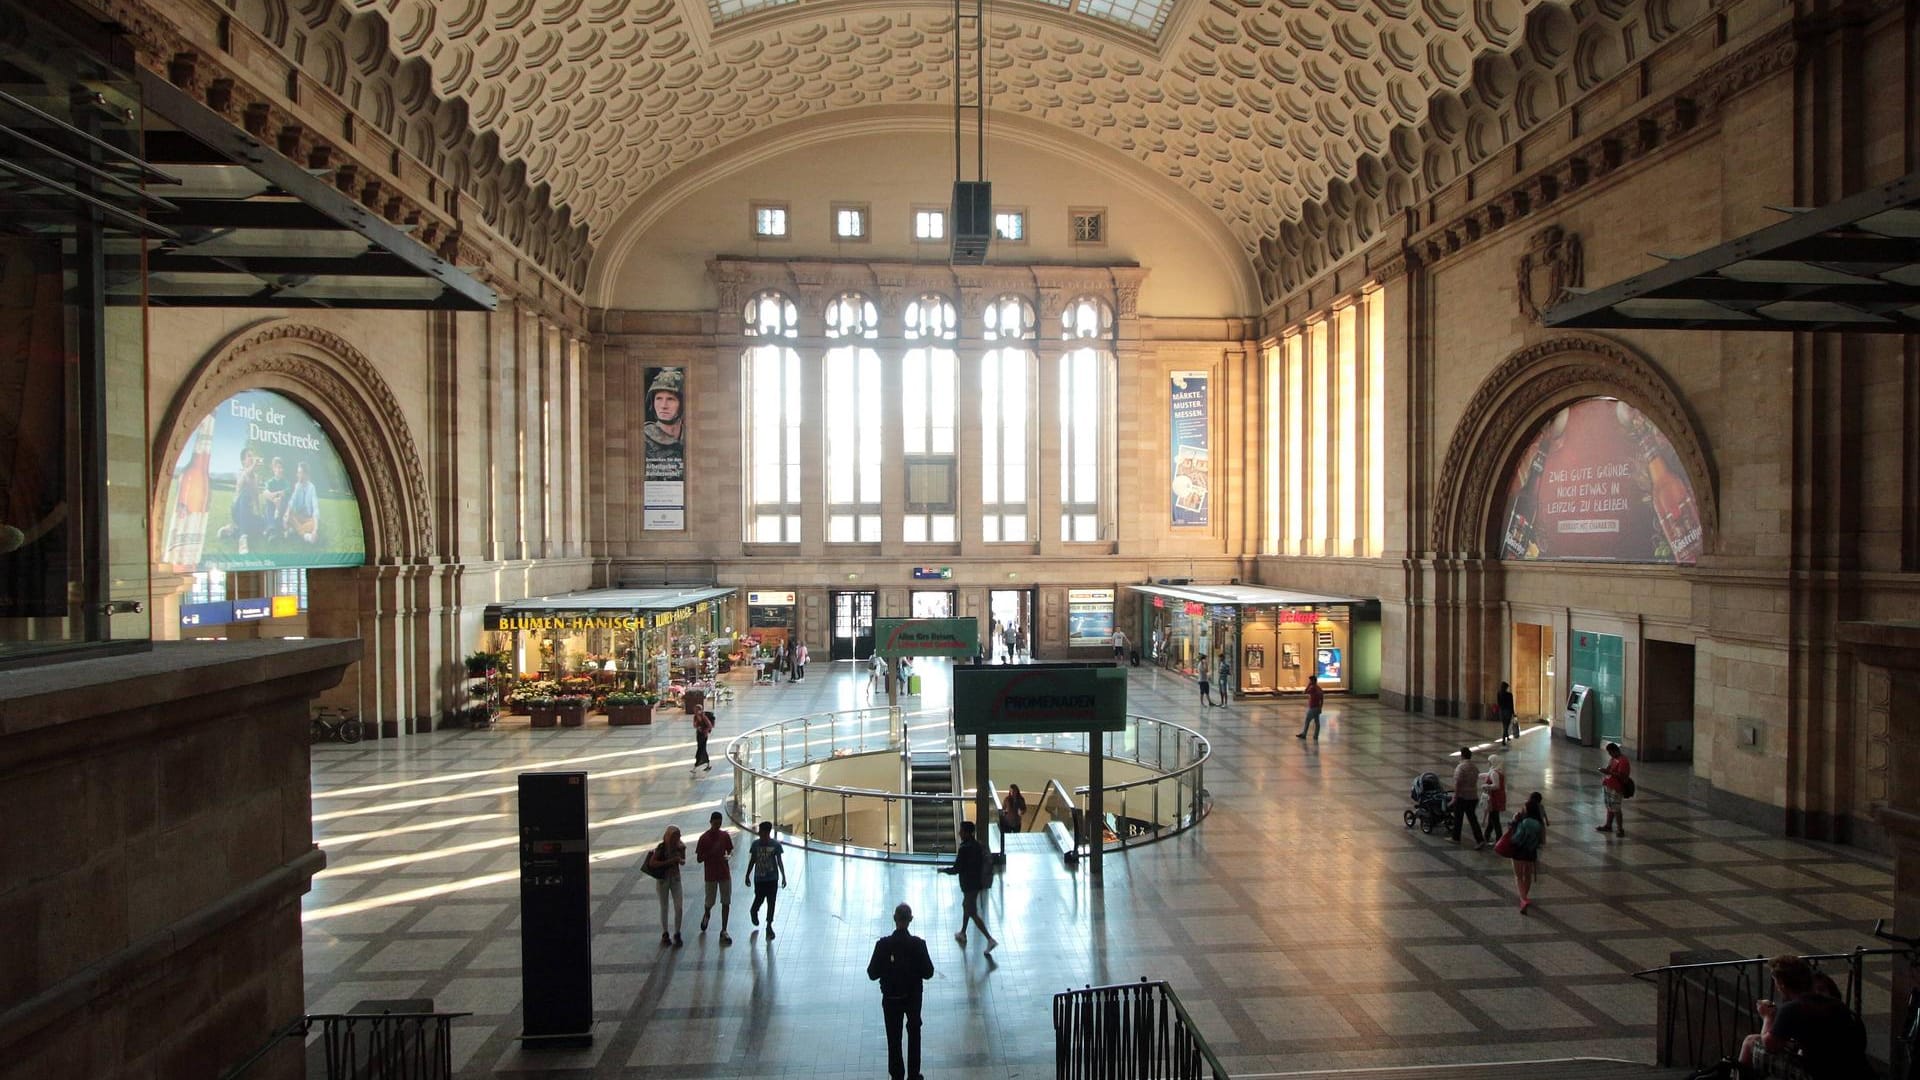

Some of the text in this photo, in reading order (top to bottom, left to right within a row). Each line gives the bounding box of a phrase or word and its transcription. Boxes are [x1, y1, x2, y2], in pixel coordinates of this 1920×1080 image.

[1173, 391, 1203, 400] MÄRKTE.
[231, 399, 287, 425] Ende der
[1174, 401, 1204, 409] MUSTER.
[1174, 410, 1204, 418] MESSEN.
[250, 423, 321, 452] Durststrecke
[1549, 470, 1568, 483] ZWEI
[1571, 467, 1593, 481] GUTE
[1556, 481, 1620, 498] NOCH ETWAS IN
[1547, 498, 1628, 514] LEIPZIG ZU BLEIBEN
[499, 617, 645, 631] BLUMEN-HANISCH
[1005, 694, 1096, 709] PROMENADEN
